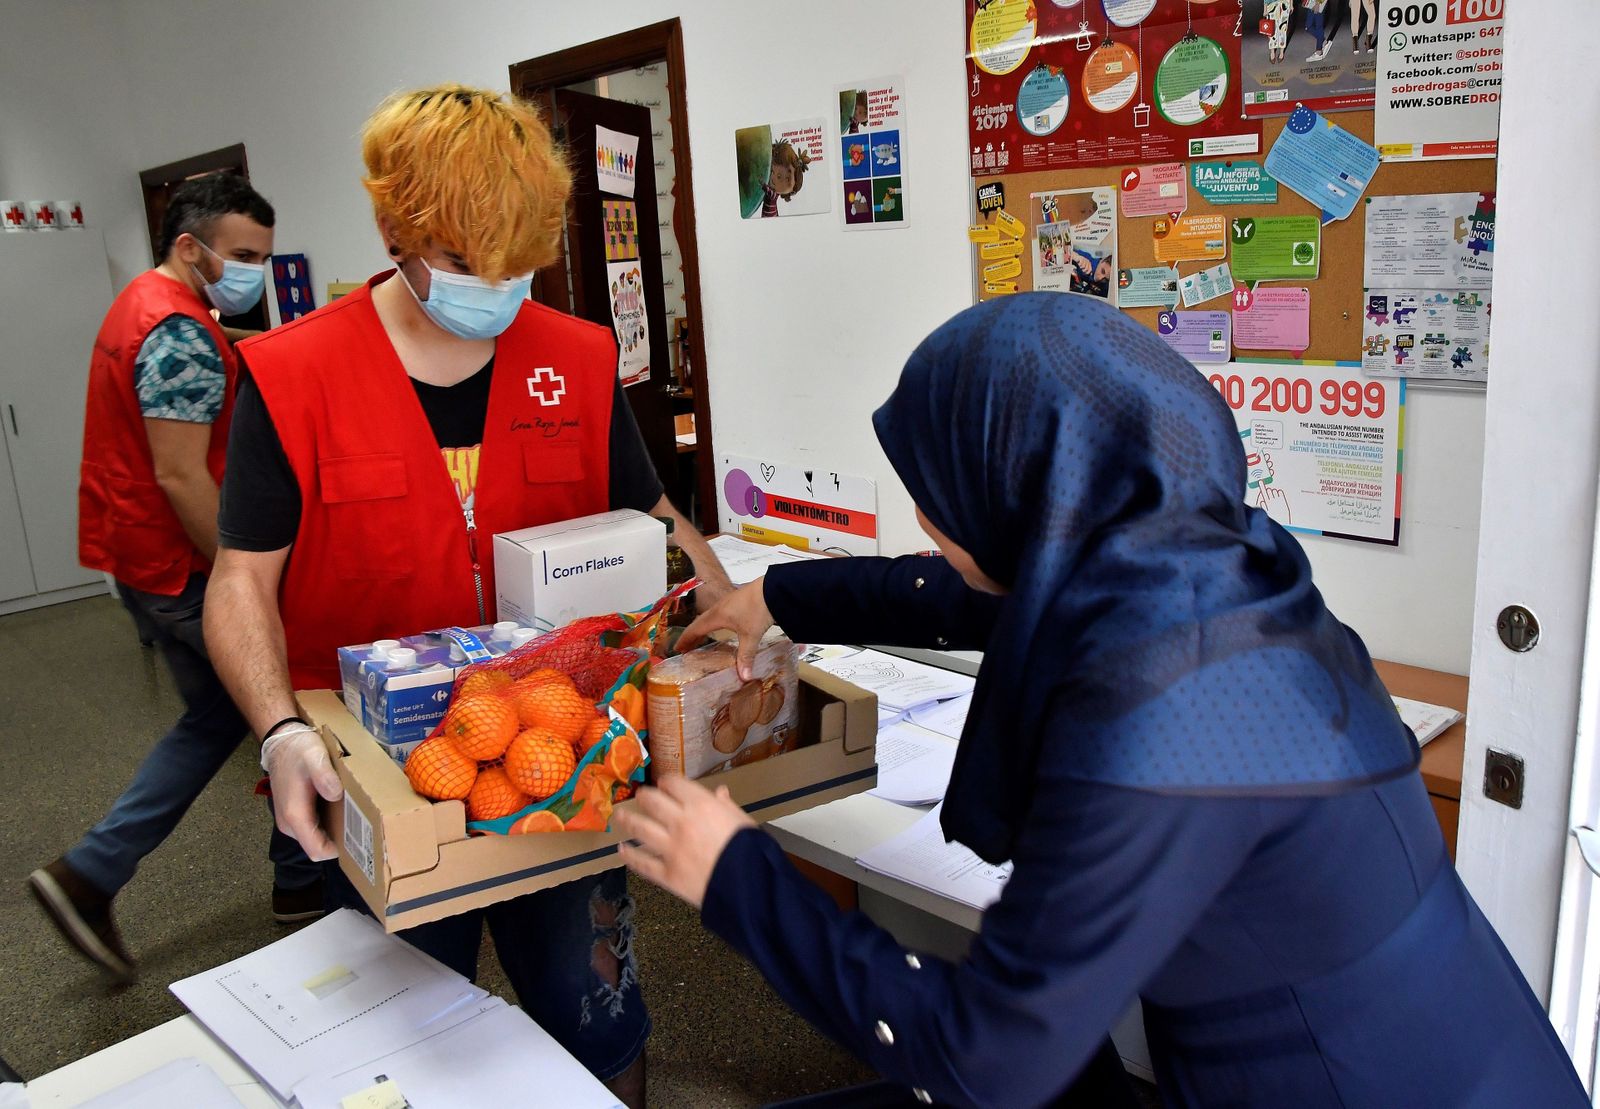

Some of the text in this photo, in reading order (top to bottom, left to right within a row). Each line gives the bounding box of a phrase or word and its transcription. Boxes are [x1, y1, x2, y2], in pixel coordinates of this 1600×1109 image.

[1387, 0, 1502, 28] 900 100
[1411, 26, 1503, 45] Whatsapp: 647
[1404, 47, 1503, 64] Twitter: @sobre
[1390, 92, 1501, 109] WWW.SOBREDRO
[973, 103, 1014, 116] diciembre
[976, 112, 1008, 131] 2019
[1153, 165, 1182, 173] PROGRAMA
[1200, 167, 1223, 180] IAJ
[1223, 171, 1261, 179] INFORMA
[978, 185, 997, 197] CARNÉ
[1211, 183, 1259, 192] JUVENTUD
[980, 196, 1004, 210] JOVEN
[1209, 374, 1386, 419] 00 200 999
[1309, 422, 1343, 431] ANDALUSIAN
[773, 500, 848, 526] VIOLENTÓMETRO
[552, 554, 624, 580] Corn Flakes
[393, 706, 411, 714] Leche
[393, 709, 449, 725] Semidesnatad
